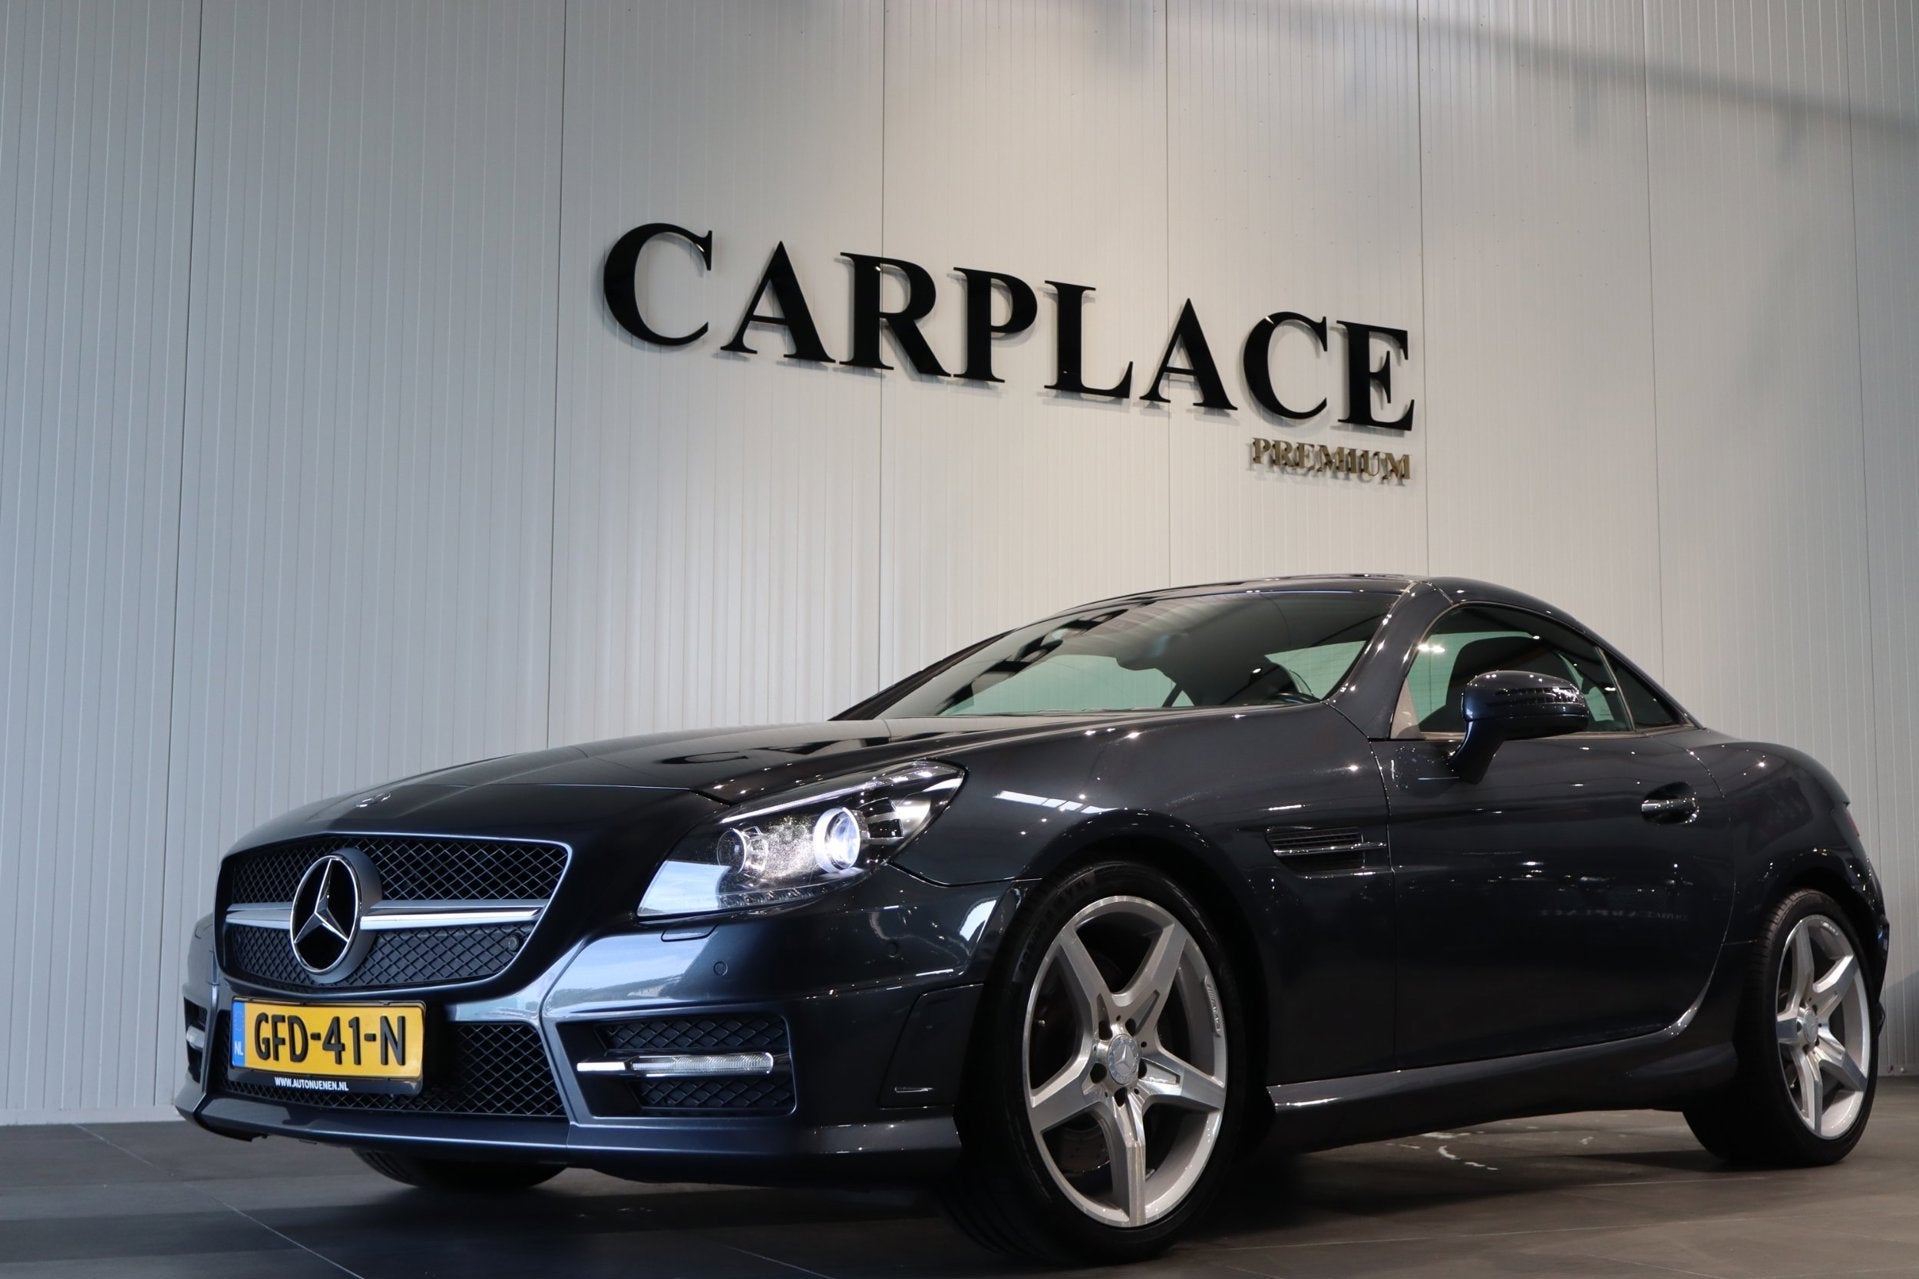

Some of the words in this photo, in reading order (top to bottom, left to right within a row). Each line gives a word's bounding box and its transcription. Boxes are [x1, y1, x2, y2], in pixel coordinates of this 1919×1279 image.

[604, 223, 1414, 432] CARPLACE
[1252, 437, 1411, 480] PREMIUM
[234, 1041, 244, 1056] NL
[255, 1012, 406, 1066] GFD-41-N
[274, 1077, 349, 1091] WWW.AUTONUENEN.NL
